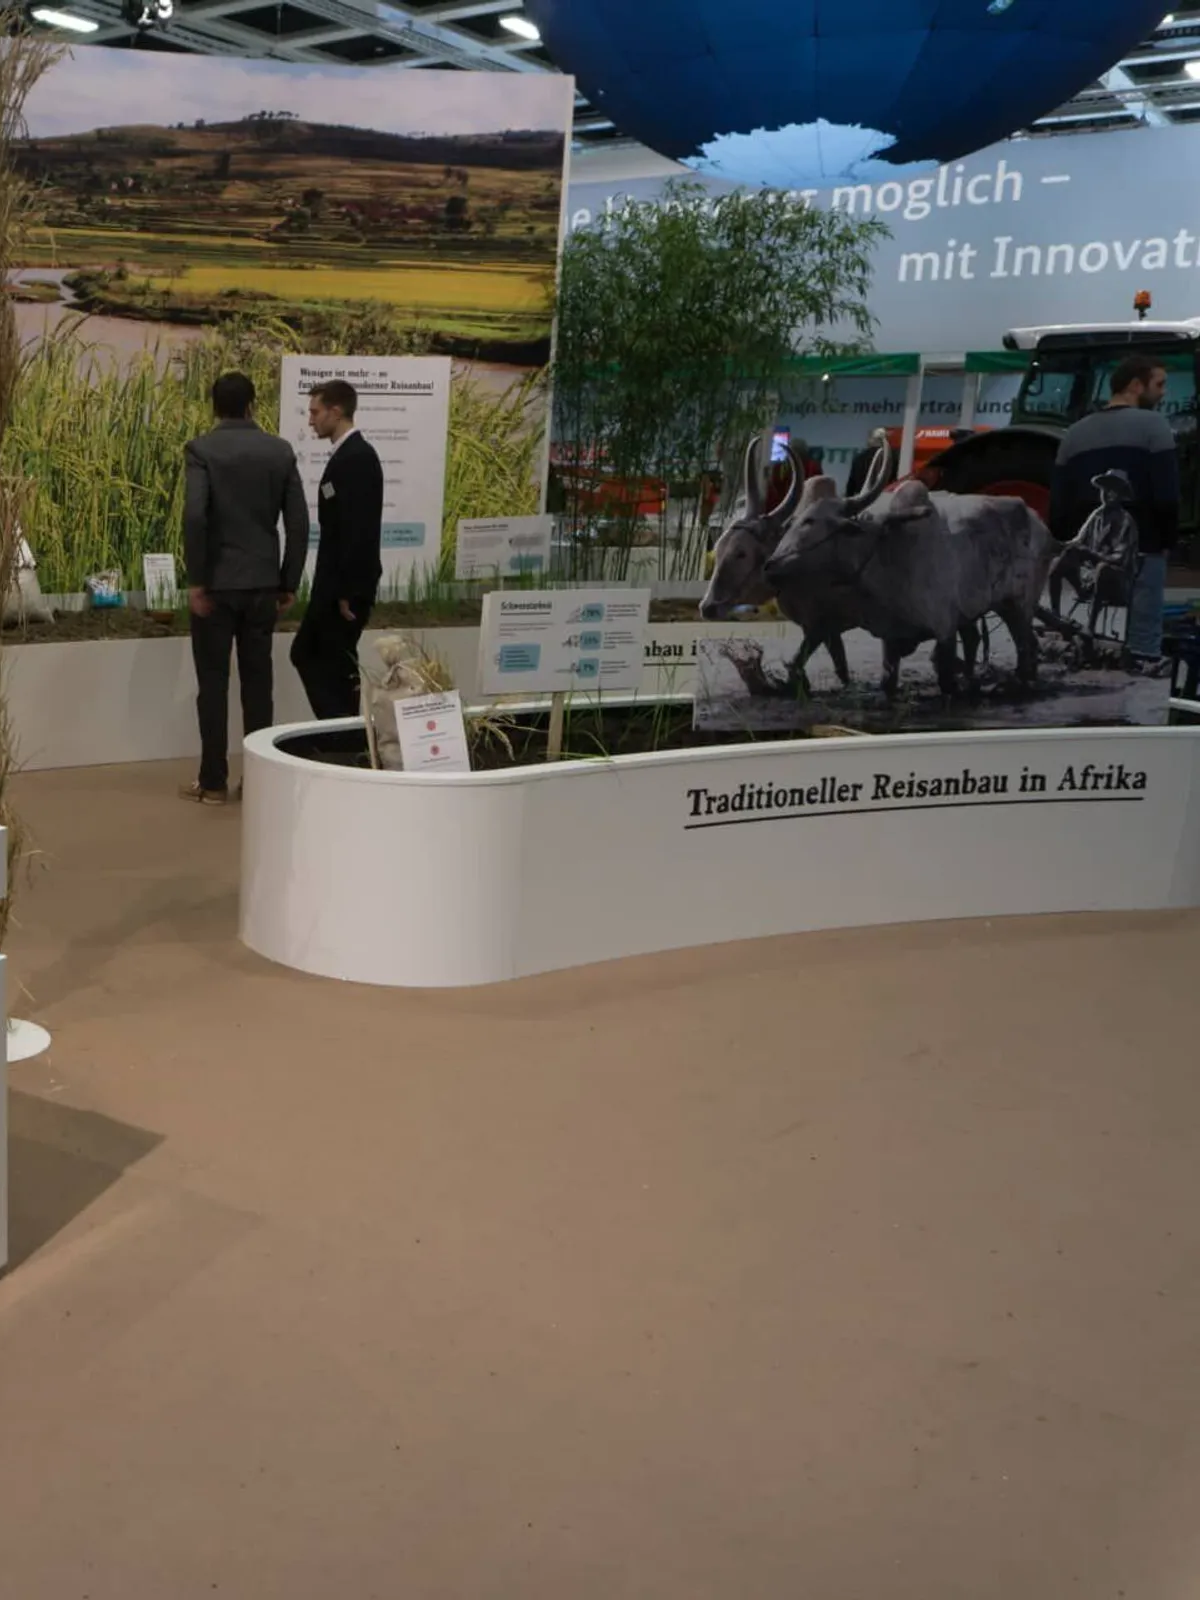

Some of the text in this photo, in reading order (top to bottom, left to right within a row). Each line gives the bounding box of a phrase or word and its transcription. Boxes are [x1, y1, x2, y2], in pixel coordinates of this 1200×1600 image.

[898, 238, 977, 282] mit
[299, 367, 333, 379] Weniger
[335, 367, 346, 378] ist
[347, 366, 370, 378] mehr
[686, 764, 1148, 818] Traditioneller Reisanbau in Afrika
